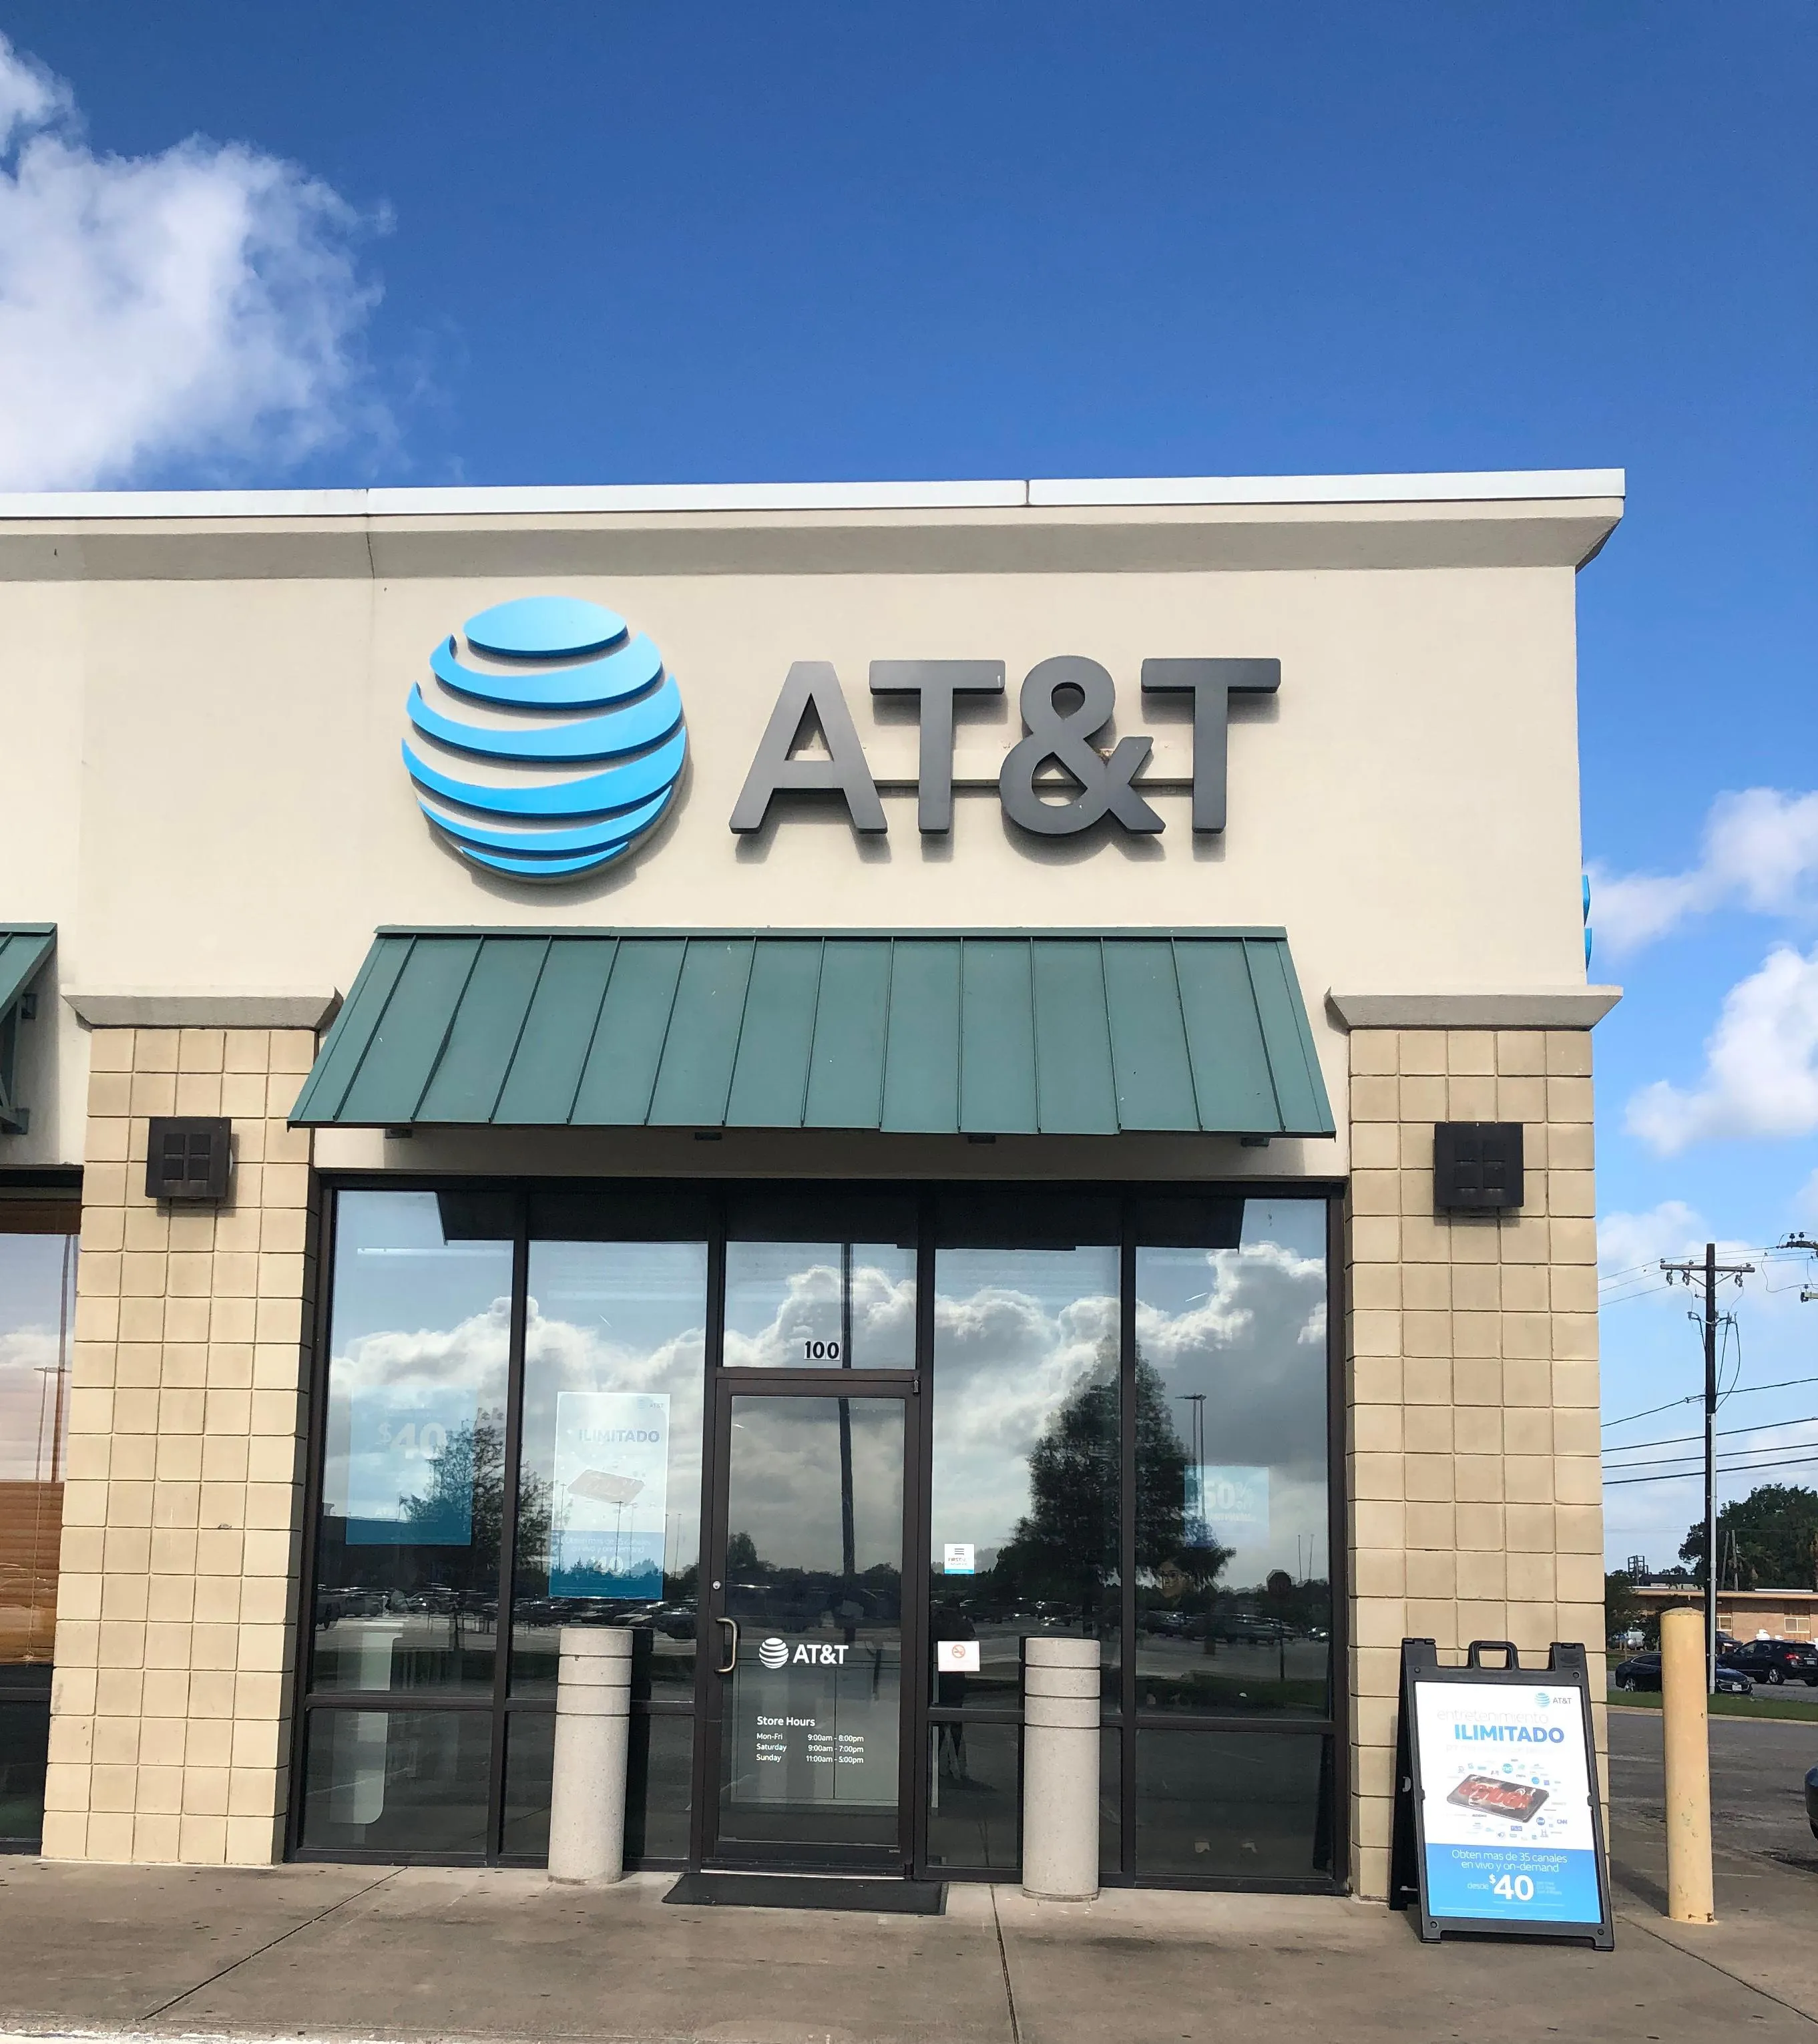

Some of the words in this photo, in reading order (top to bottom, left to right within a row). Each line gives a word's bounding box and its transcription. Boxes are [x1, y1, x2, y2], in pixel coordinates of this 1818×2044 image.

[729, 655, 1281, 835] AT&T
[805, 1341, 839, 1359] 100
[579, 1429, 660, 1443] ILIMITADO
[792, 1644, 849, 1665] AT&T
[756, 1716, 784, 1725] Store
[786, 1717, 815, 1727] Hours
[1455, 1724, 1565, 1744] ILIMITADO
[756, 1744, 787, 1752] Saturday
[756, 1754, 782, 1763] Sunday
[1452, 1849, 1482, 1859] Obten
[1484, 1852, 1503, 1860] mas
[1506, 1851, 1517, 1861] de
[1520, 1852, 1530, 1862] 35
[1532, 1854, 1567, 1863] canales
[1461, 1861, 1473, 1869] en
[1474, 1862, 1494, 1870] vivo
[1496, 1863, 1502, 1872] y
[1504, 1862, 1560, 1873] on-demand
[1489, 1873, 1534, 1901] $40
